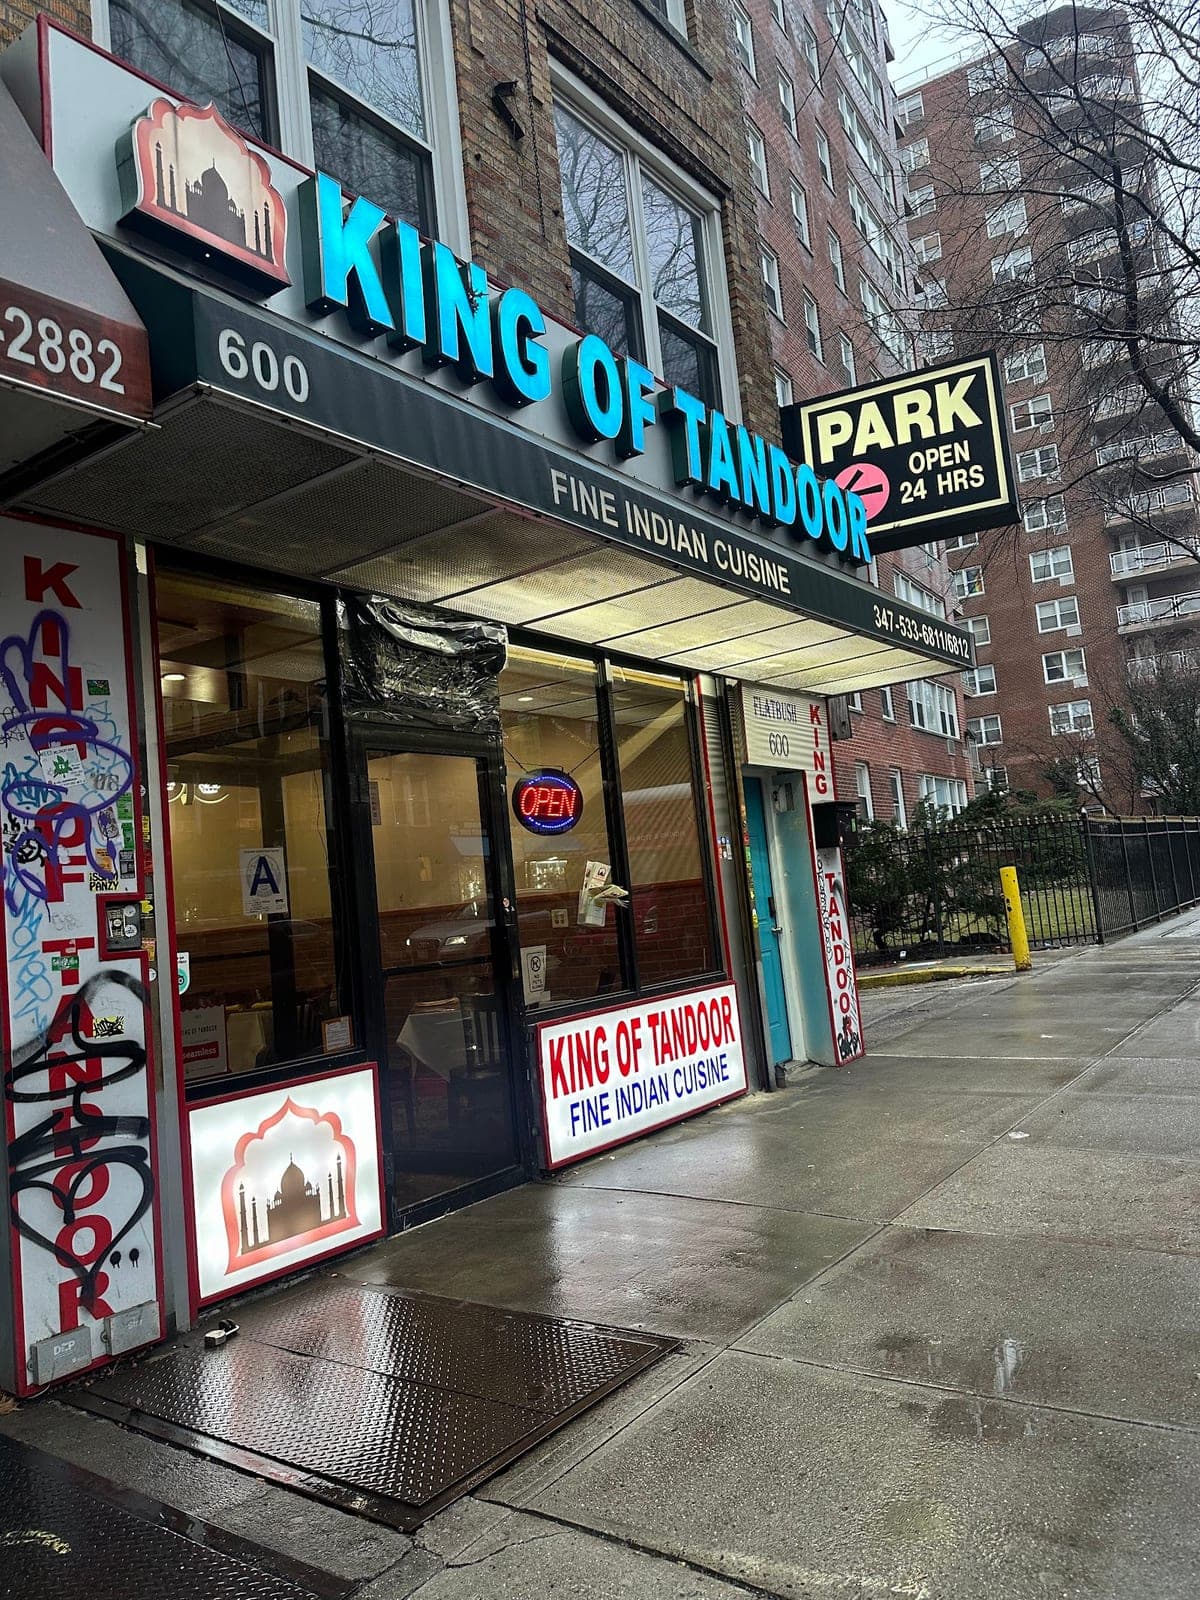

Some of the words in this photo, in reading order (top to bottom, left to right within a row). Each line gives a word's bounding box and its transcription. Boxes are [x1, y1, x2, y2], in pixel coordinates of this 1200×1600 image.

[218, 328, 310, 403] 600
[316, 170, 552, 402] KING
[576, 333, 656, 457] OF
[672, 384, 872, 564] TANDOOR
[816, 373, 983, 464] PARK
[899, 480, 928, 503] 24
[936, 464, 986, 495] HRS
[908, 438, 971, 476] OPEN
[550, 468, 619, 529] FINE
[625, 500, 709, 564] INDIAN
[713, 539, 792, 595] CUISINE
[873, 604, 970, 660] 347-533-6811/6812
[753, 696, 798, 722] FLATBUSH
[768, 732, 790, 757] 600
[809, 703, 828, 795] KING
[521, 786, 576, 817] OPEN
[89, 881, 119, 892] PANZY
[249, 855, 280, 897] A
[548, 1025, 610, 1100] KING
[616, 1017, 643, 1077] OF
[647, 995, 736, 1062] TANDOOR
[569, 1091, 611, 1138] FINE
[615, 1071, 669, 1121] INDIAN
[673, 1052, 730, 1098] CUISINE
